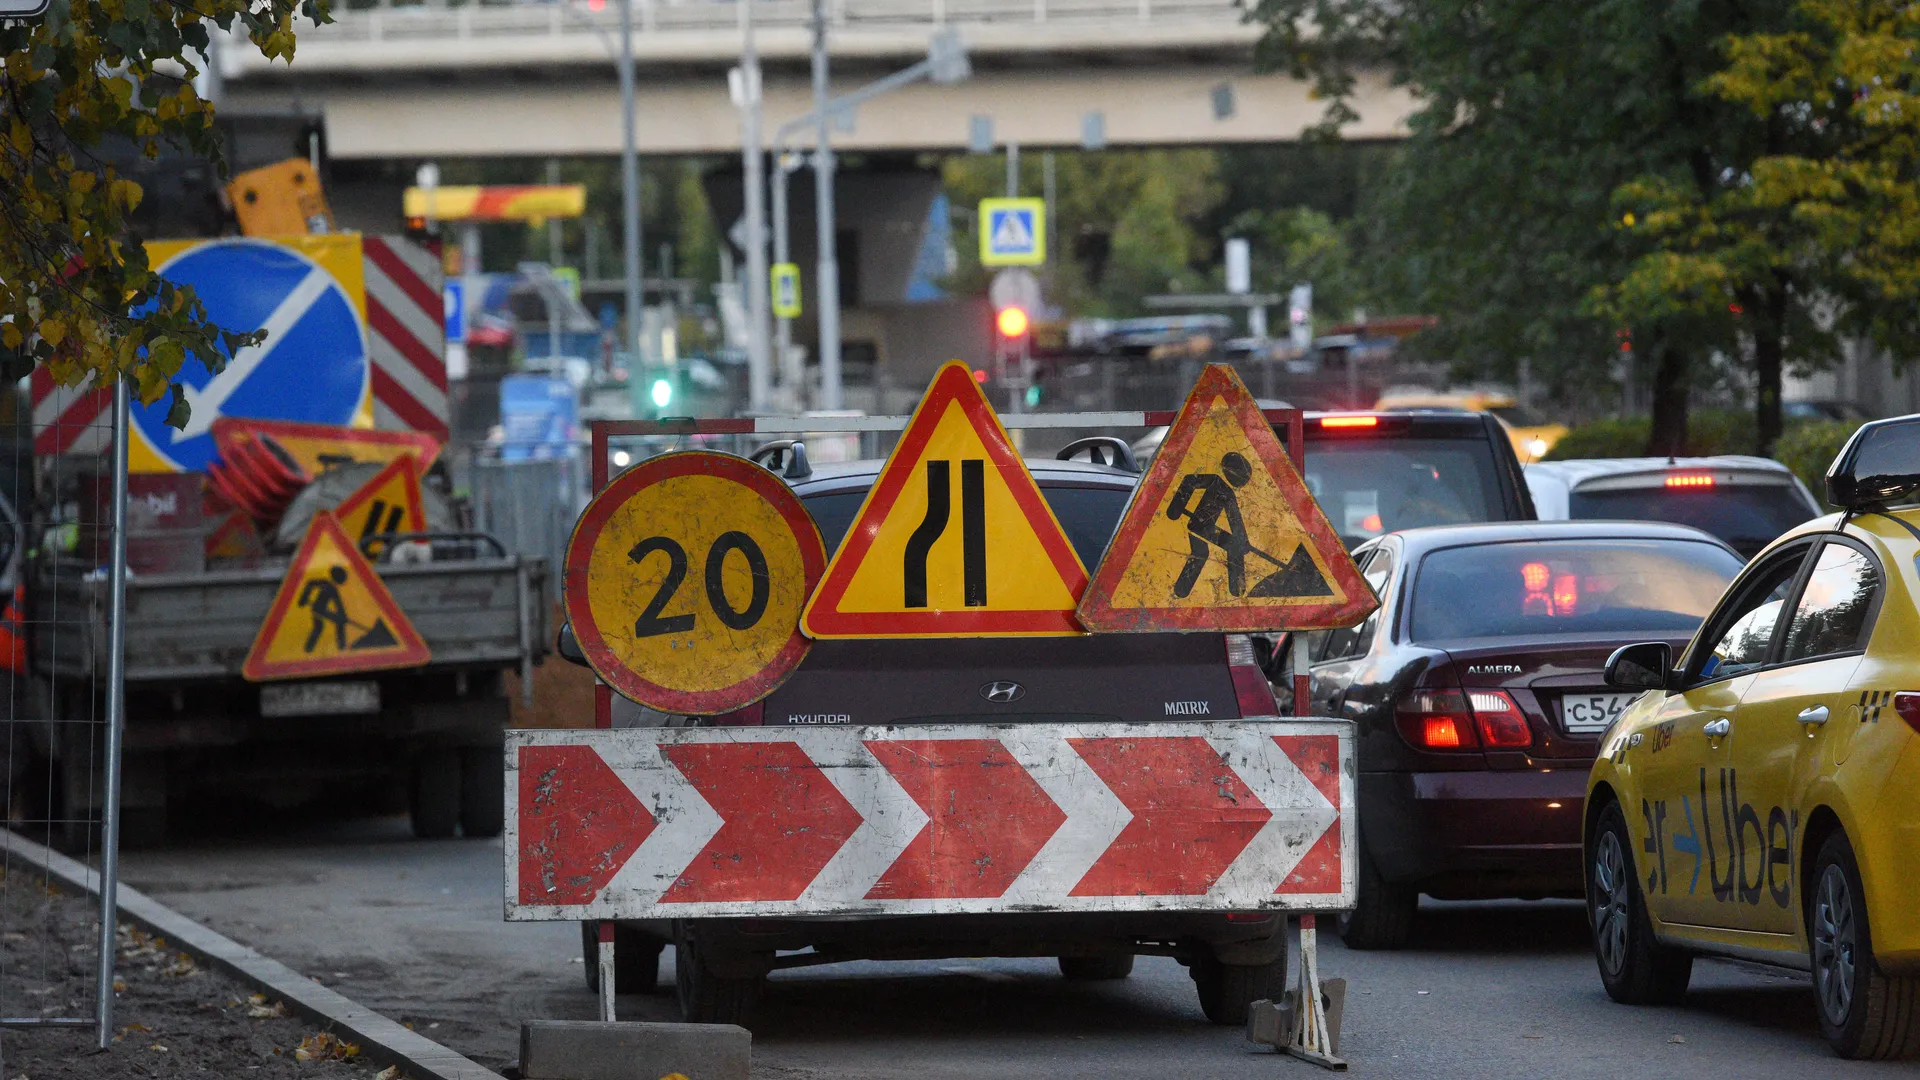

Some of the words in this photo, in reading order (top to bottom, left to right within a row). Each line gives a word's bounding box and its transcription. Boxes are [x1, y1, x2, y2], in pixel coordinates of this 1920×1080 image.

[627, 530, 770, 639] 20
[1467, 665, 1522, 674] ALMERA
[788, 714, 851, 724] HYUNDAI
[1164, 701, 1210, 716] MATRIX
[1652, 723, 1675, 754] Uber
[1700, 767, 1799, 909] Uber
